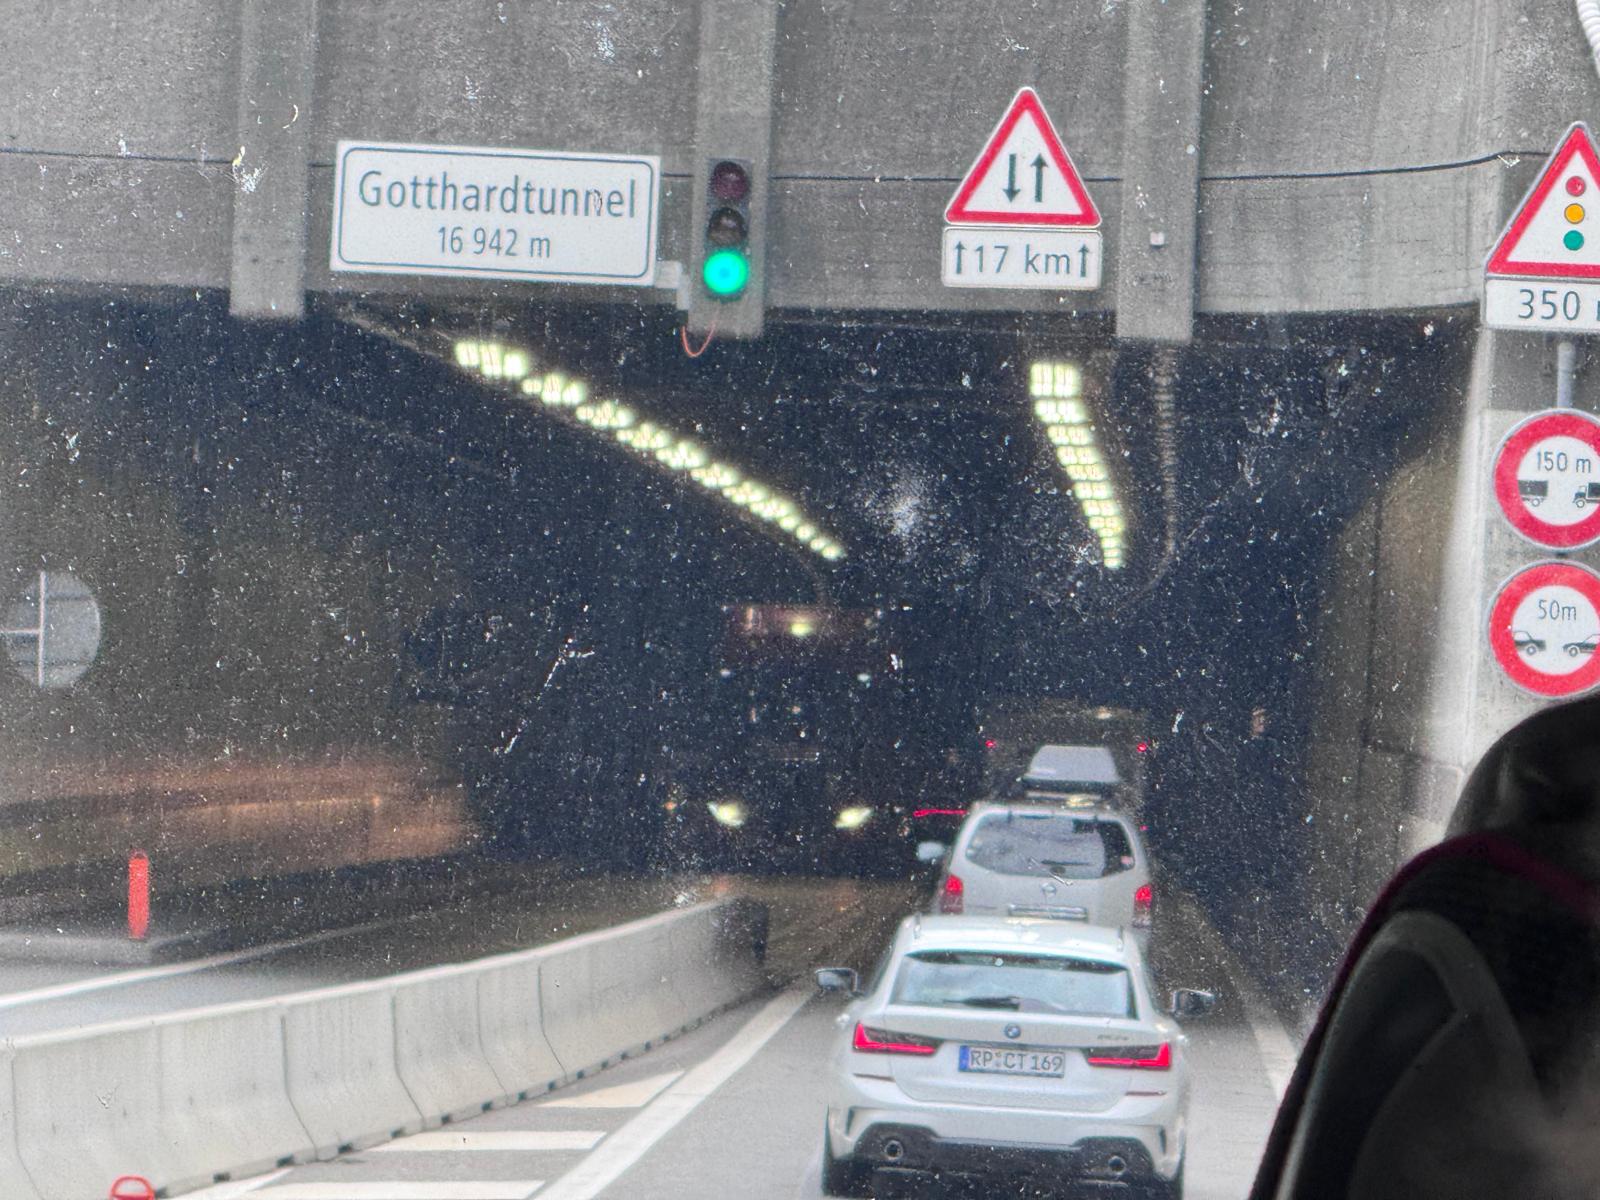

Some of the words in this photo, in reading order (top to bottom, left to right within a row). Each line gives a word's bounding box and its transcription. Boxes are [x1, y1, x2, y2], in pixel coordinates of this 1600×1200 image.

[358, 170, 635, 218] Gotthardtunnel
[529, 236, 551, 258] m
[975, 244, 1009, 273] 17
[1024, 243, 1071, 275] km
[1518, 288, 1580, 321] 350
[1537, 451, 1568, 472] 150
[1576, 458, 1591, 473] m
